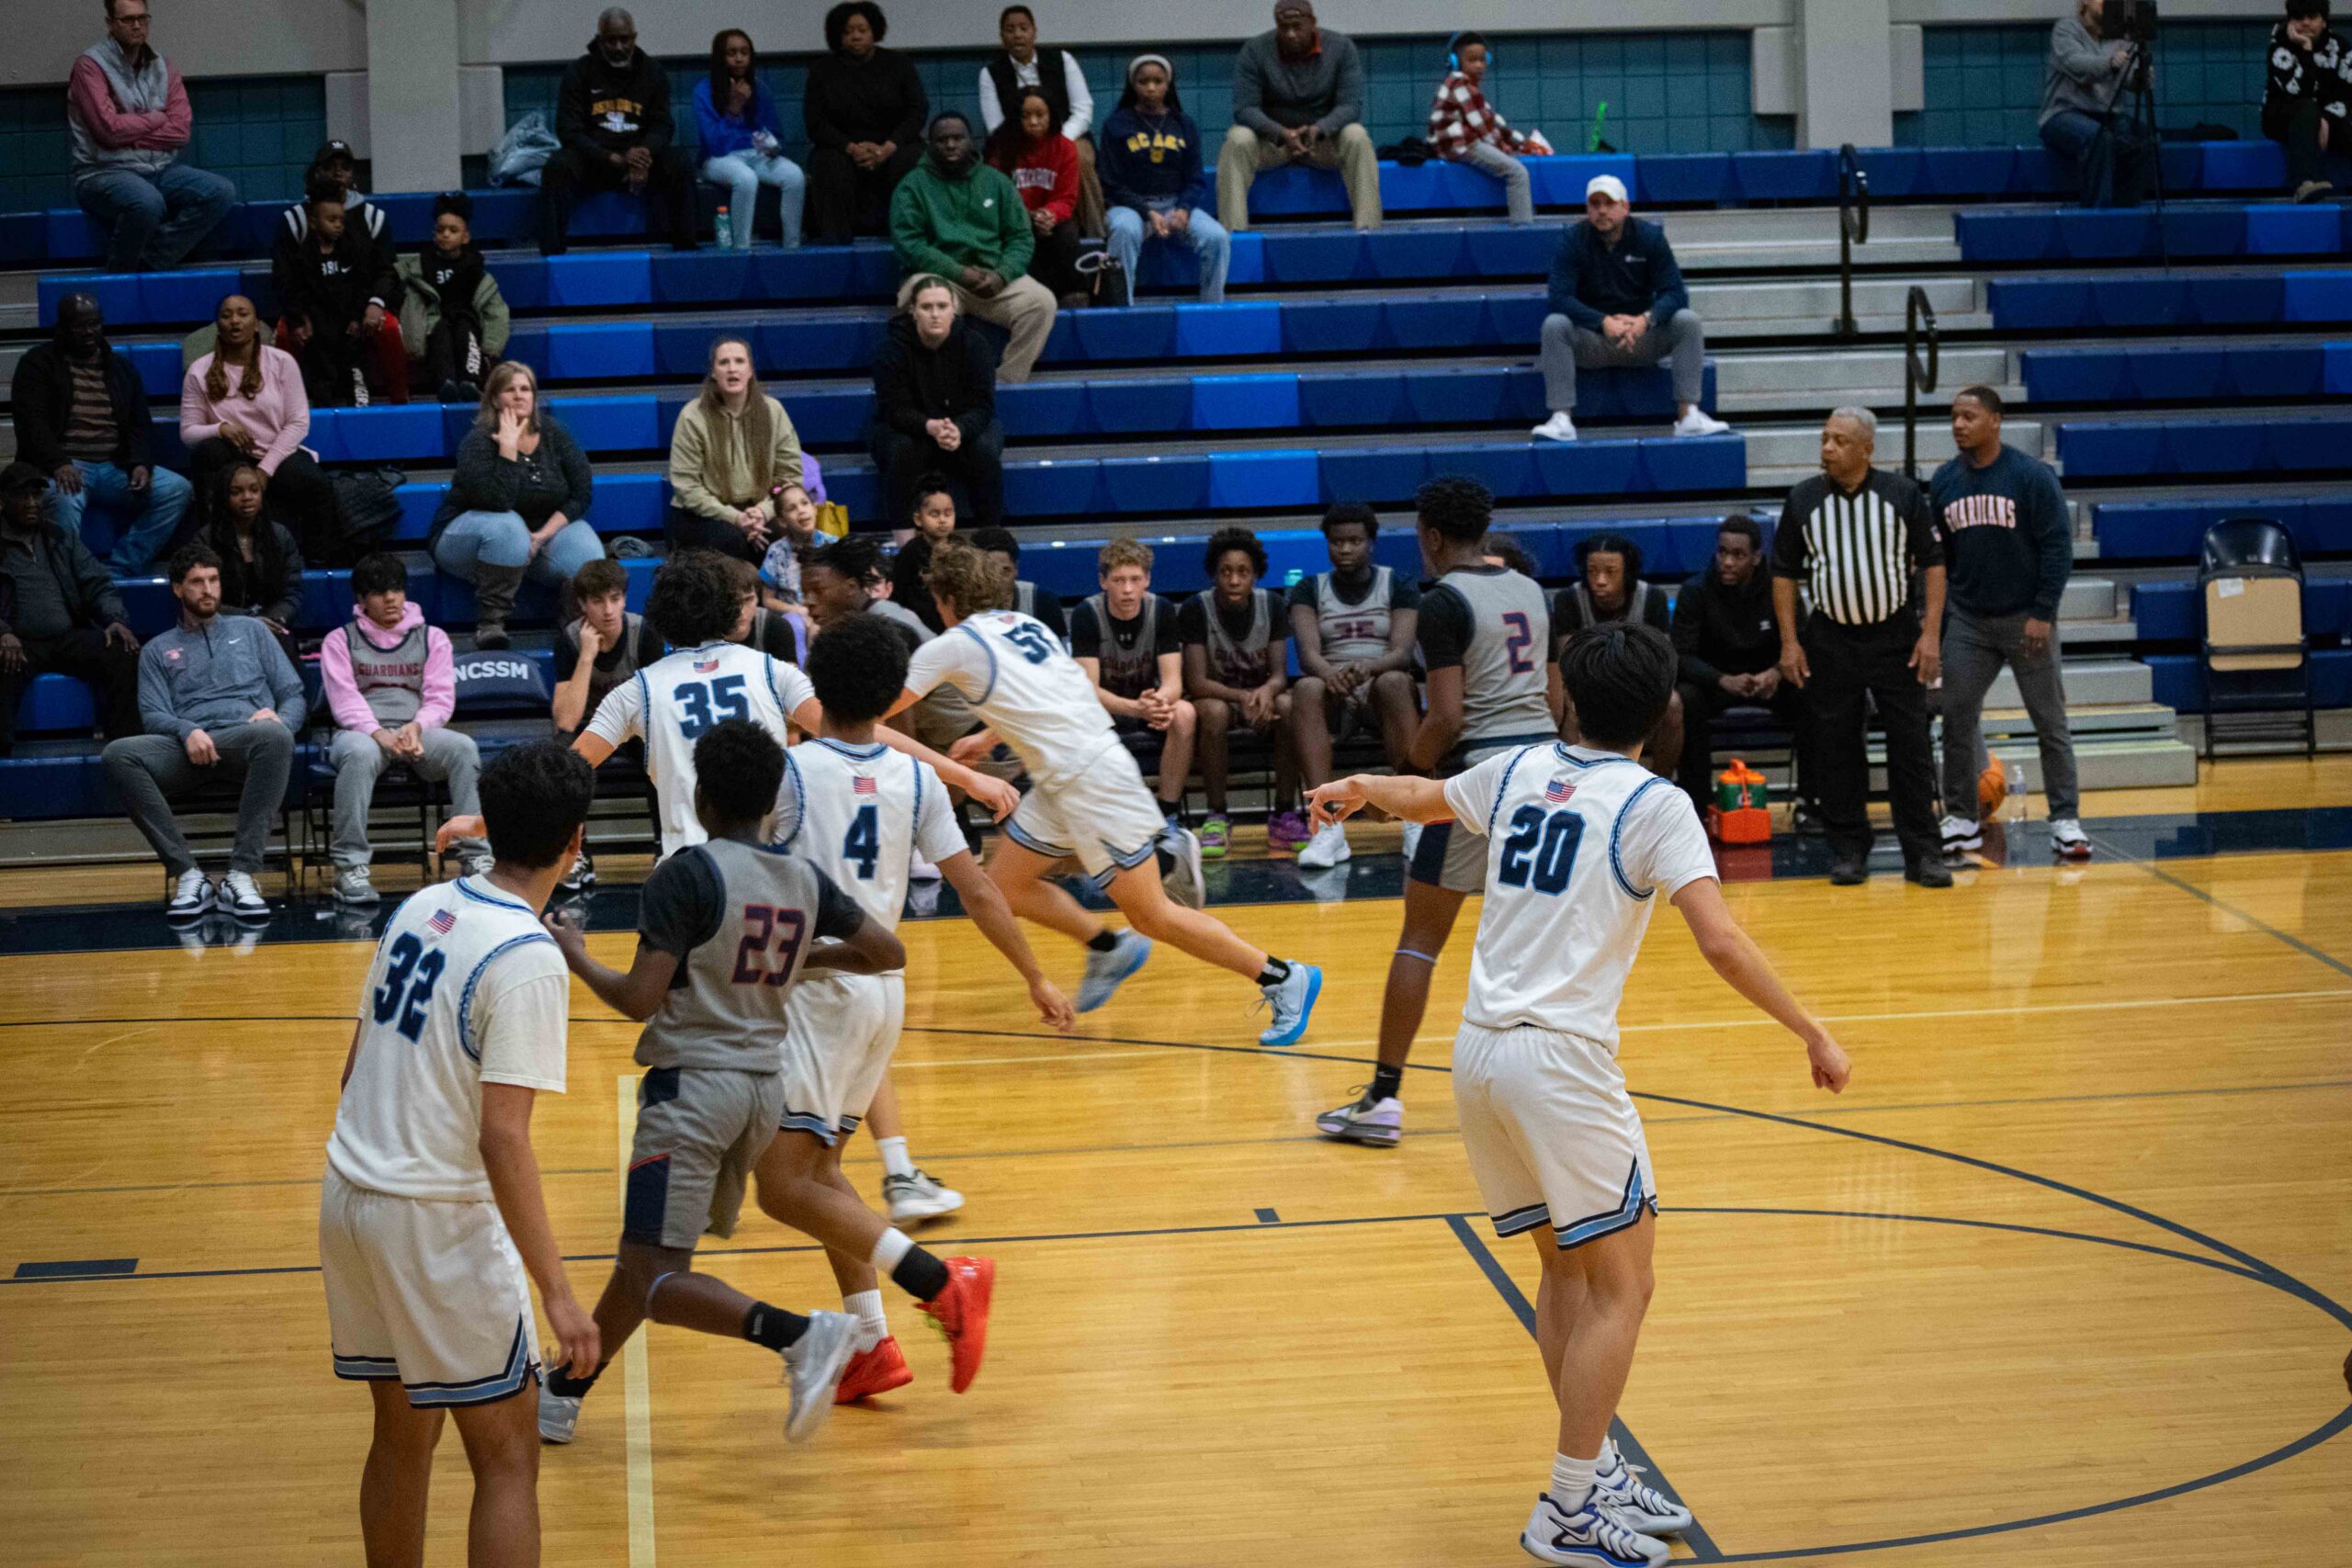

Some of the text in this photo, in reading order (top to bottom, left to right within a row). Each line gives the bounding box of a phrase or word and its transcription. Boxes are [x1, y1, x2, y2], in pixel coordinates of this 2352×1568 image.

[357, 662, 420, 677] GUARDIANS
[454, 660, 529, 683] NCSSM
[1501, 611, 1534, 675] 2
[673, 673, 751, 740] 35
[842, 804, 881, 880] 4
[1498, 803, 1587, 897] 20
[730, 903, 807, 987] 23
[374, 931, 447, 1044] 32
